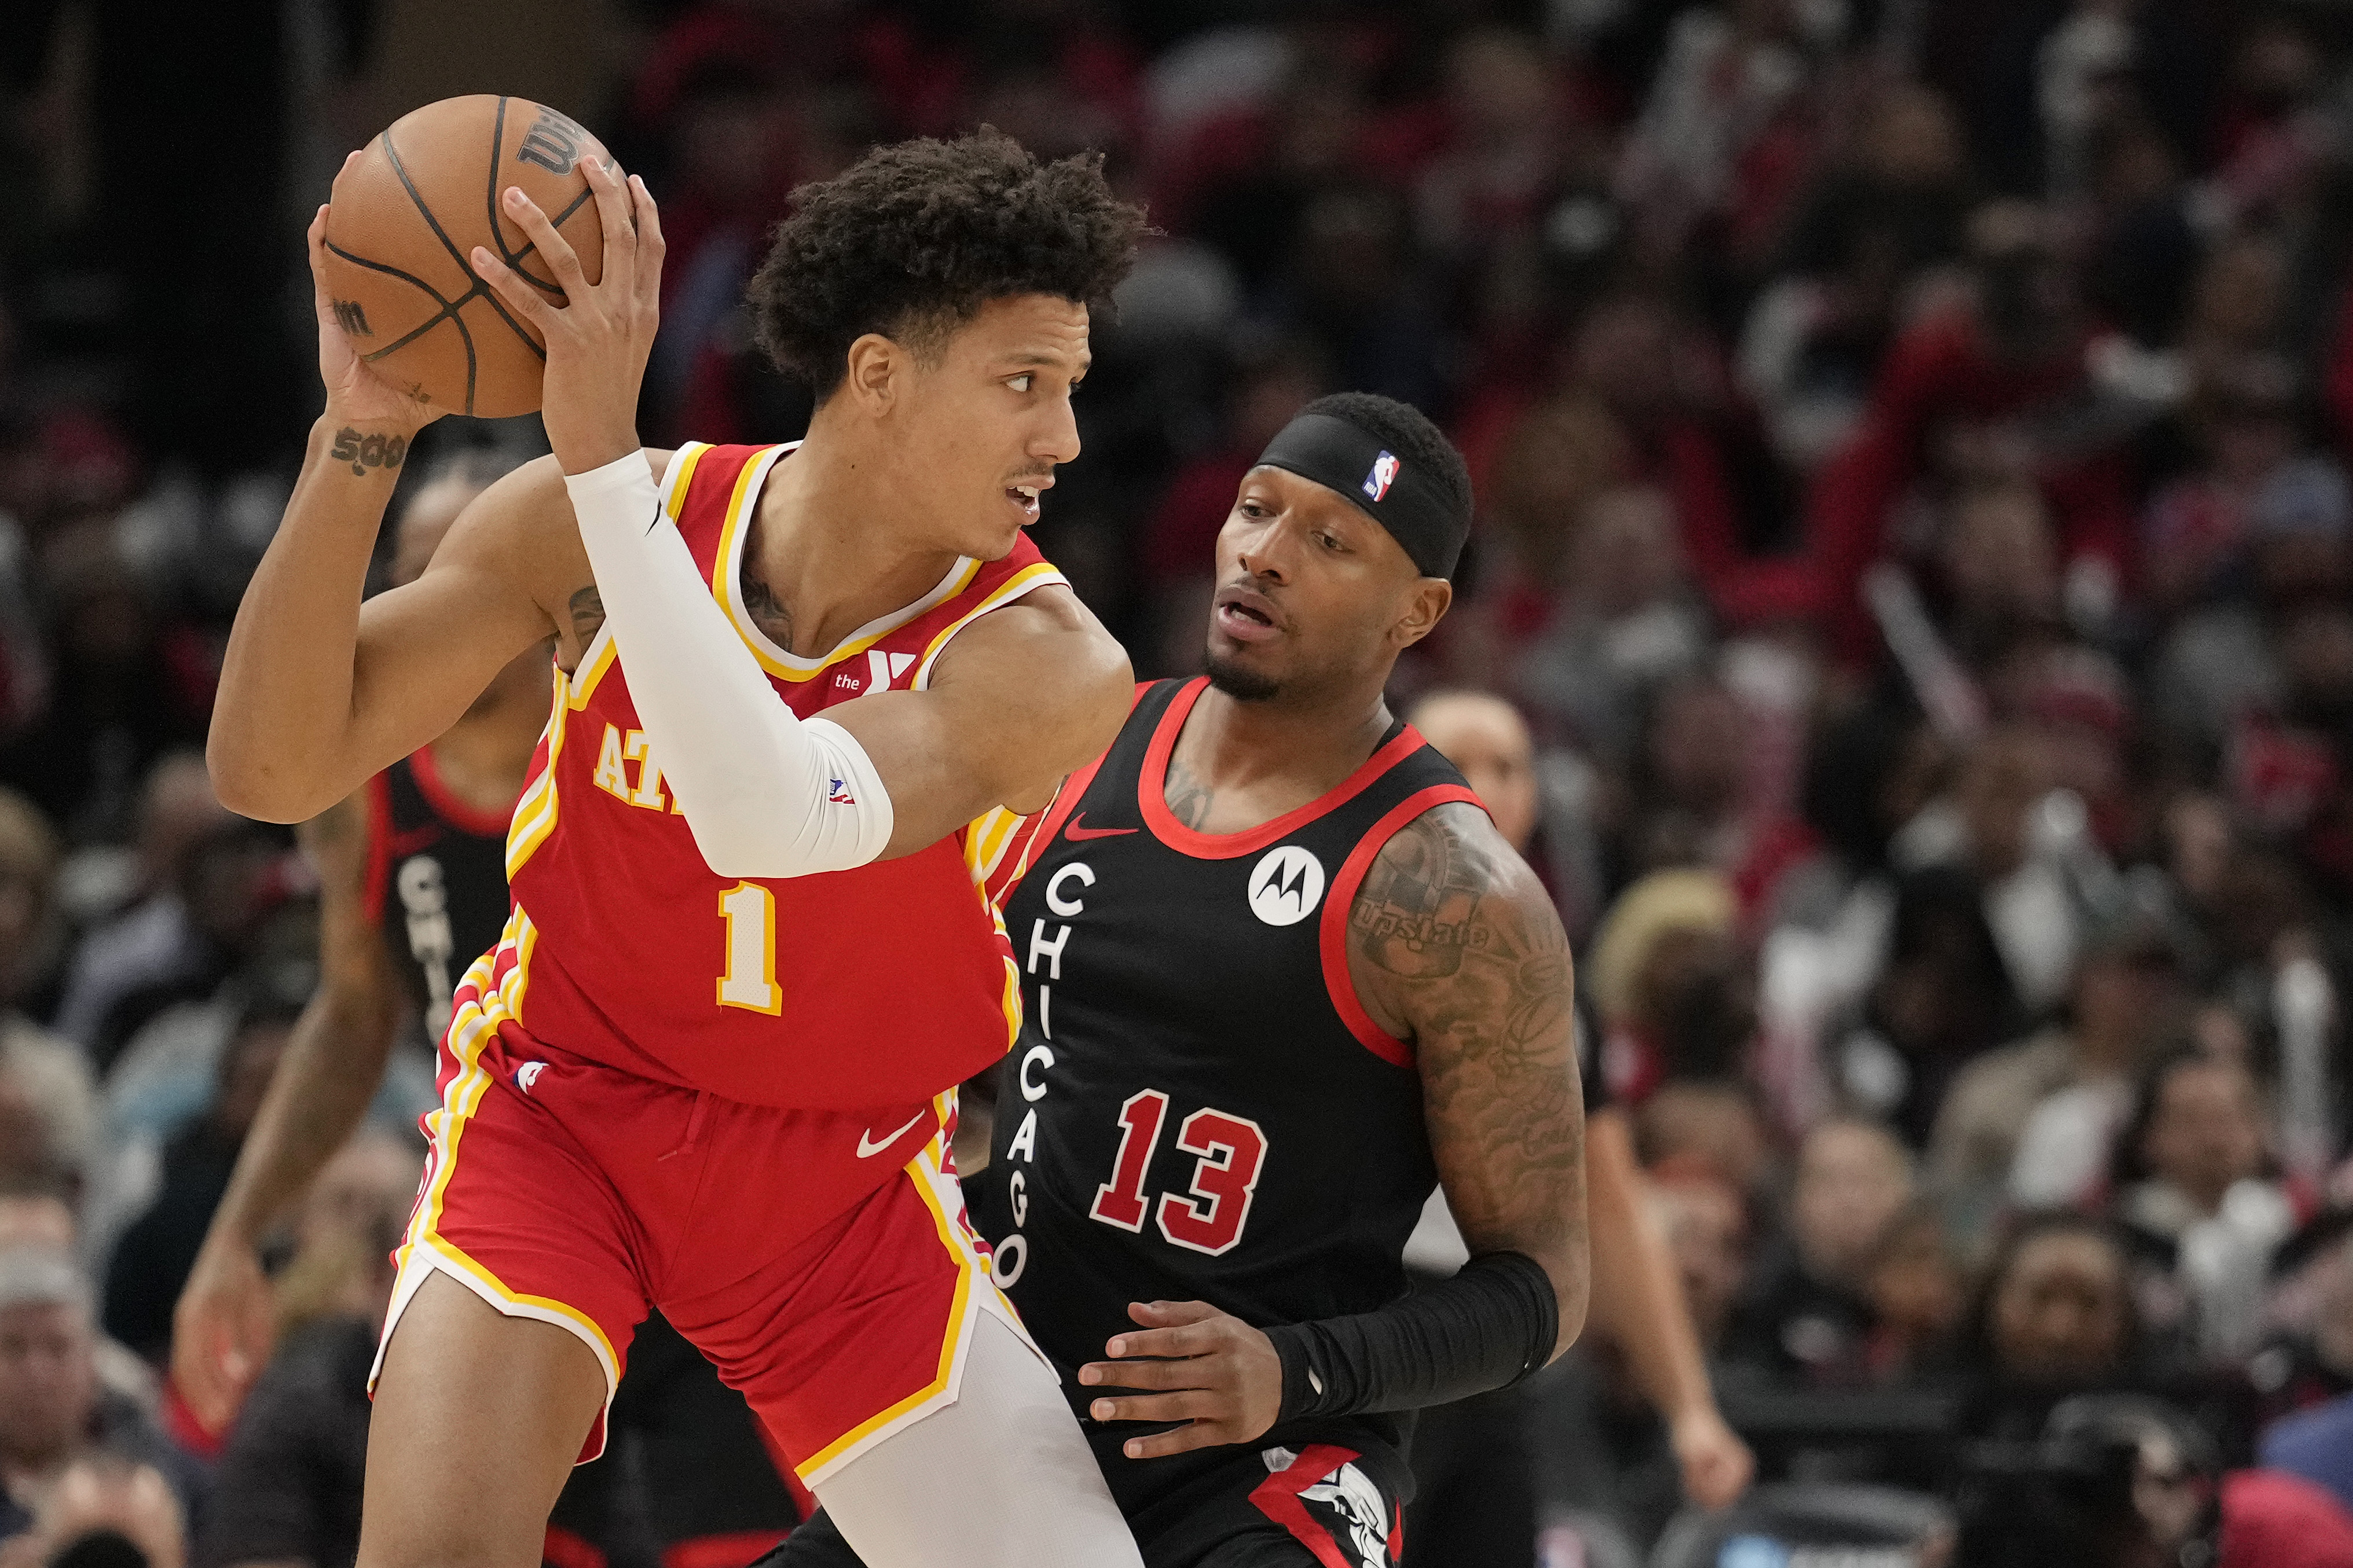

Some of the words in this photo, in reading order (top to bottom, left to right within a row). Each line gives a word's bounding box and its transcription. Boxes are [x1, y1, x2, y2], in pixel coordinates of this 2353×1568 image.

[835, 674, 860, 690] the
[593, 722, 684, 815] AT
[716, 880, 782, 1016] 1
[991, 862, 1095, 1288] CHICAGO
[1089, 1088, 1268, 1257] 13
